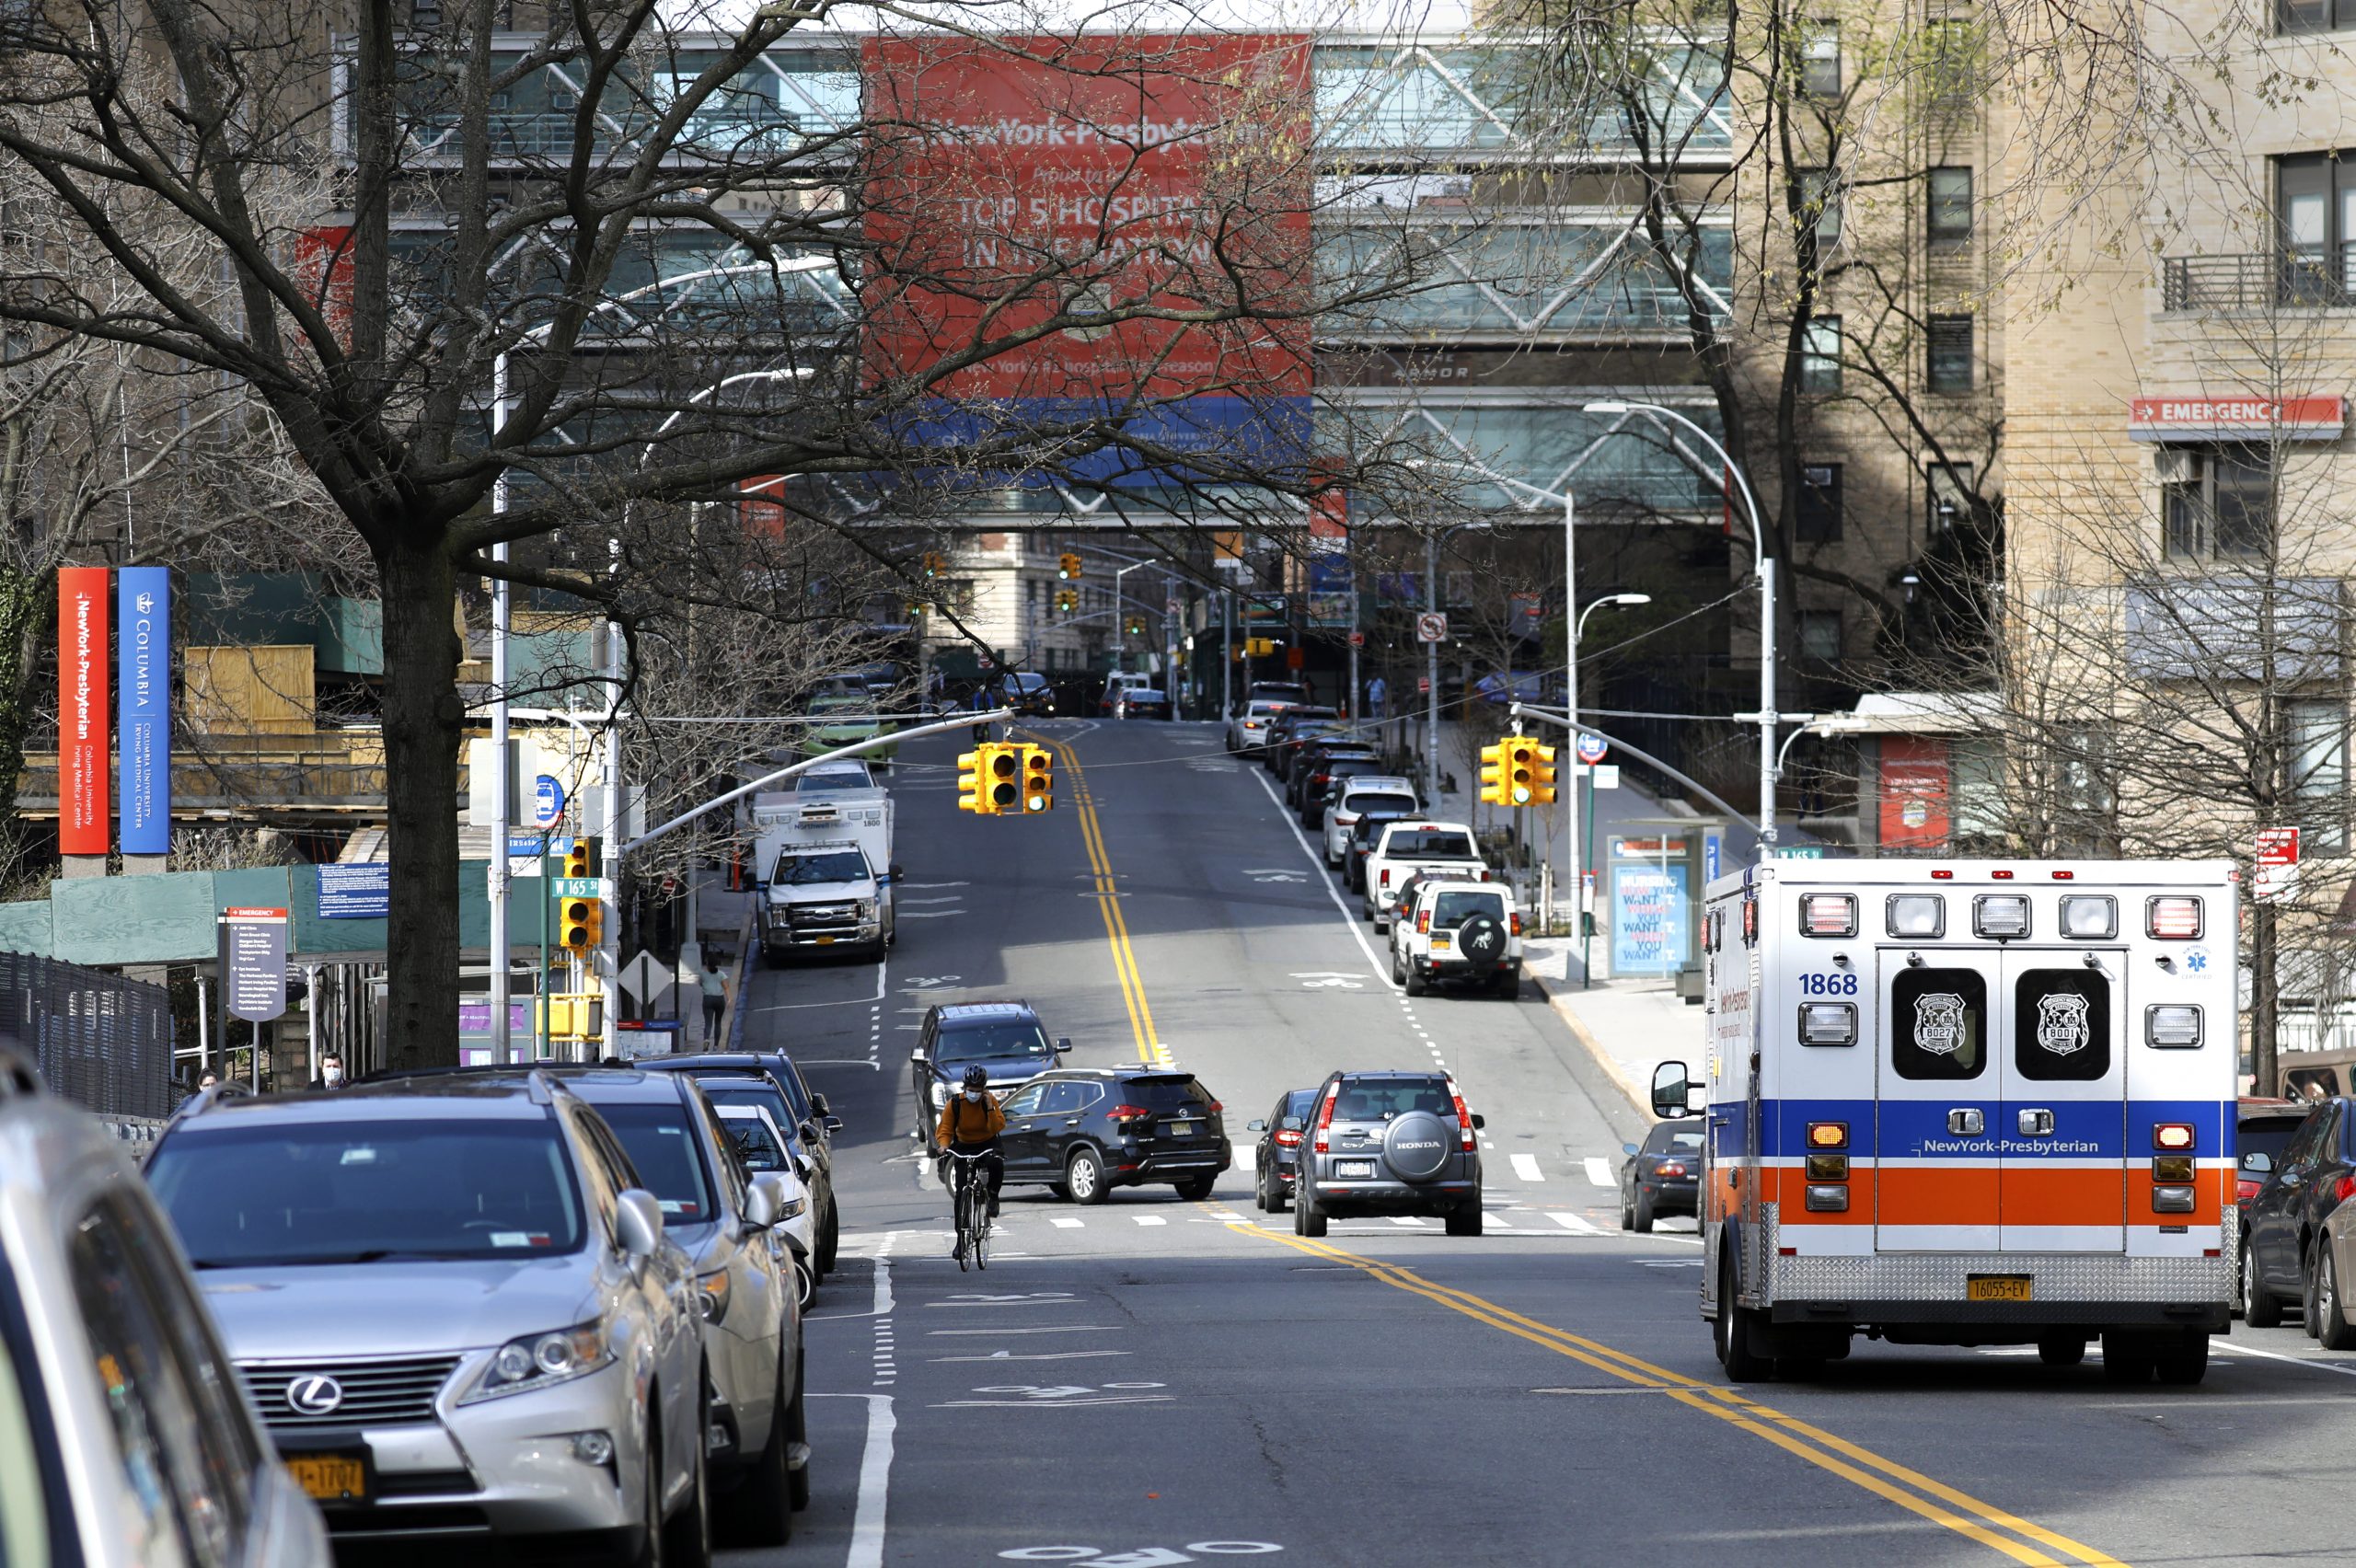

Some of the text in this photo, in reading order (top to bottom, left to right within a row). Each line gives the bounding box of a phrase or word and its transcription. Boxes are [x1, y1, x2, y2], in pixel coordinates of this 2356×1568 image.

[930, 116, 1265, 153] NewYork-Presbyte
[1033, 167, 1081, 183] Proud
[957, 196, 1209, 226] TOP 5 HOSPITA
[963, 237, 998, 266] IN
[75, 600, 91, 740] NewYork-Presbyterian
[136, 619, 151, 708] COLUMBIA
[134, 755, 143, 792] MEDICAL
[143, 722, 152, 818] COLUMBIA UNIVERSITY
[72, 744, 82, 829] Irving Medical Center
[85, 744, 94, 825] Columbia University
[134, 795, 143, 829] CENTER
[863, 820, 881, 828] 1800
[1707, 857, 1715, 882] Washi
[555, 880, 598, 895] W 165 St
[1623, 894, 1659, 905] WANT
[238, 909, 274, 917] EMERGENCY
[1637, 914, 1662, 923] YOU
[1623, 922, 1659, 932] WANT
[1636, 941, 1662, 951] YOU
[1623, 950, 1659, 961] WANT
[1797, 973, 1858, 996] 1868
[1927, 1028, 1951, 1038] 8027
[2050, 1029, 2074, 1038] 8001
[1396, 1140, 1441, 1150] HONDA
[1924, 1140, 2098, 1157] NewYork-Presbyterian
